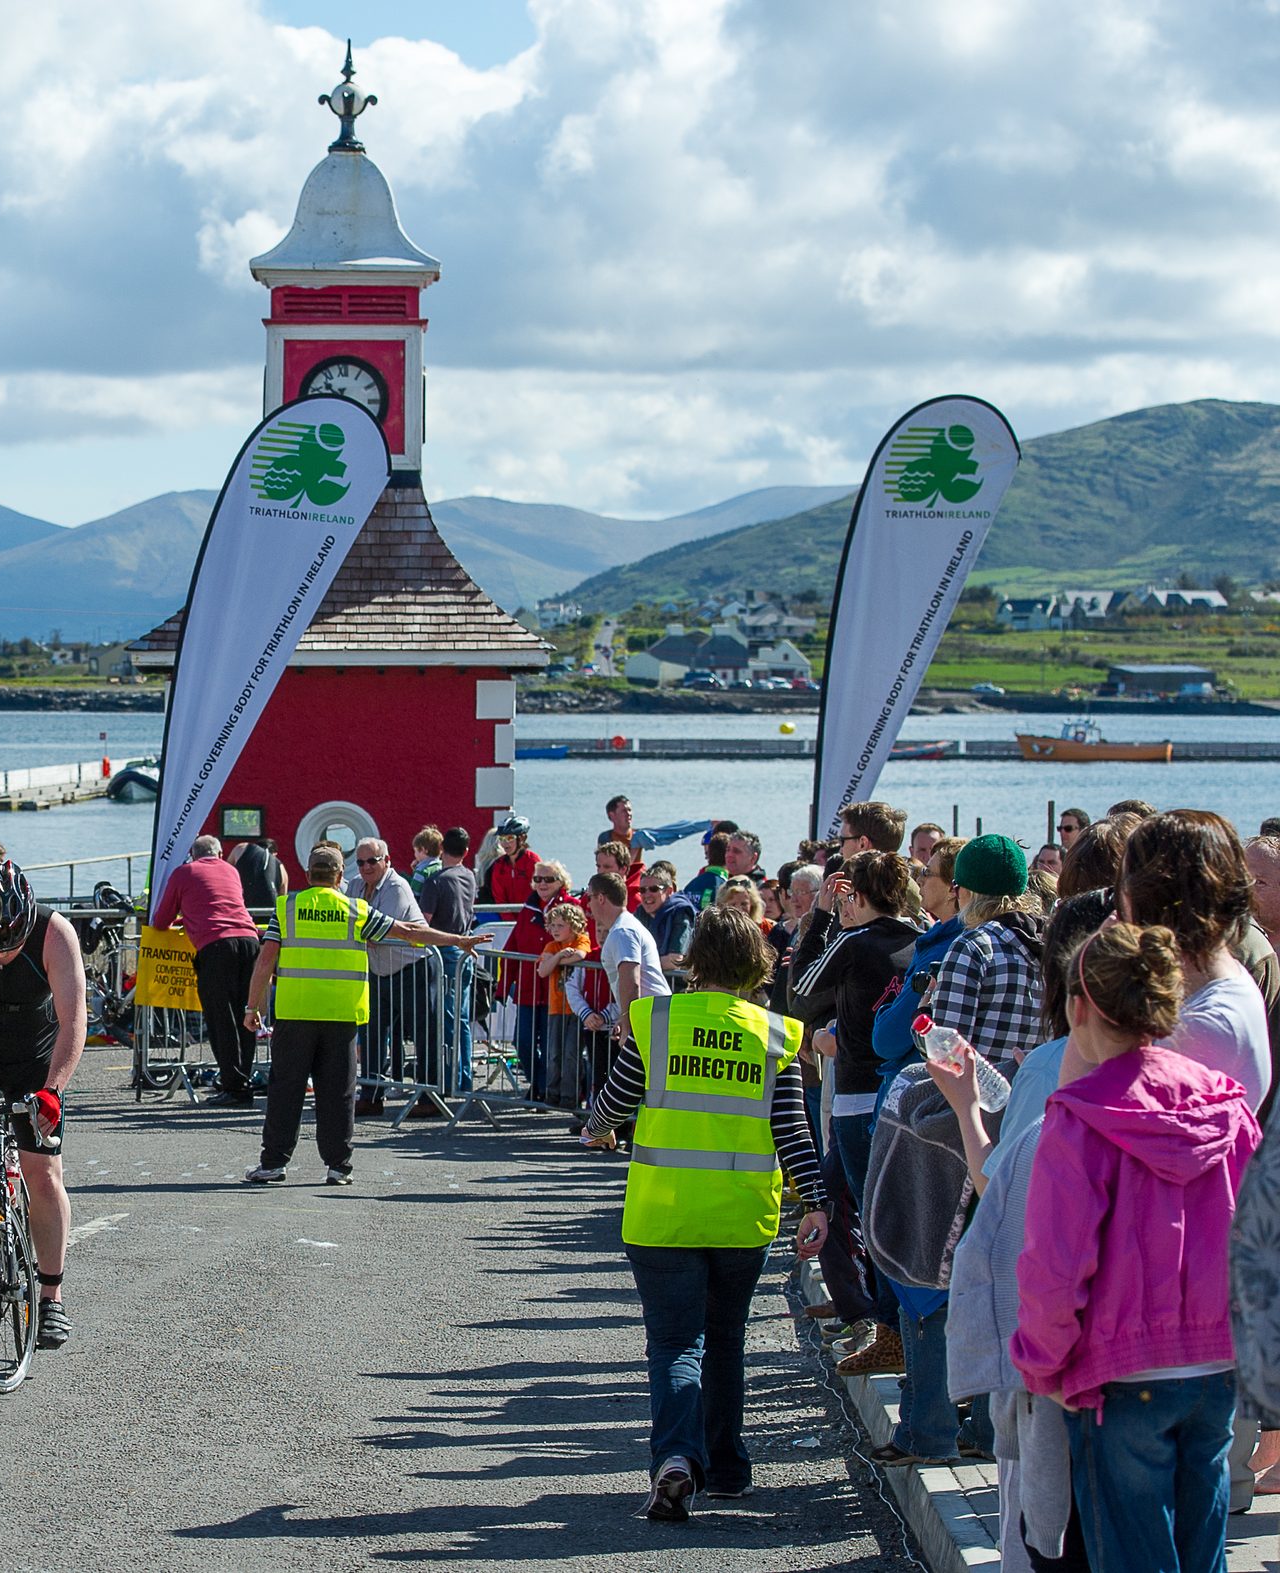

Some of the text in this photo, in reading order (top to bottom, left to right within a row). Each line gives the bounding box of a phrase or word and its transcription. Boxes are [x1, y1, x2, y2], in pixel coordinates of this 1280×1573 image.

[944, 530, 973, 577] IRELAND
[938, 578, 951, 591] IN
[910, 591, 944, 650] TRIATHLON
[900, 651, 916, 674] FOR
[160, 535, 335, 860] THE NATIONAL GOVERNING BODY FOR TRIATHLON IN IRELAND
[886, 675, 905, 706] BODY
[857, 707, 892, 771] GOVERNING
[832, 774, 862, 828] NTIONAL
[298, 909, 345, 922] MARSHAL
[142, 947, 194, 963] TRANSITION
[154, 975, 169, 984] AND
[693, 1027, 743, 1052] RACE
[669, 1055, 762, 1084] DIRECTOR
